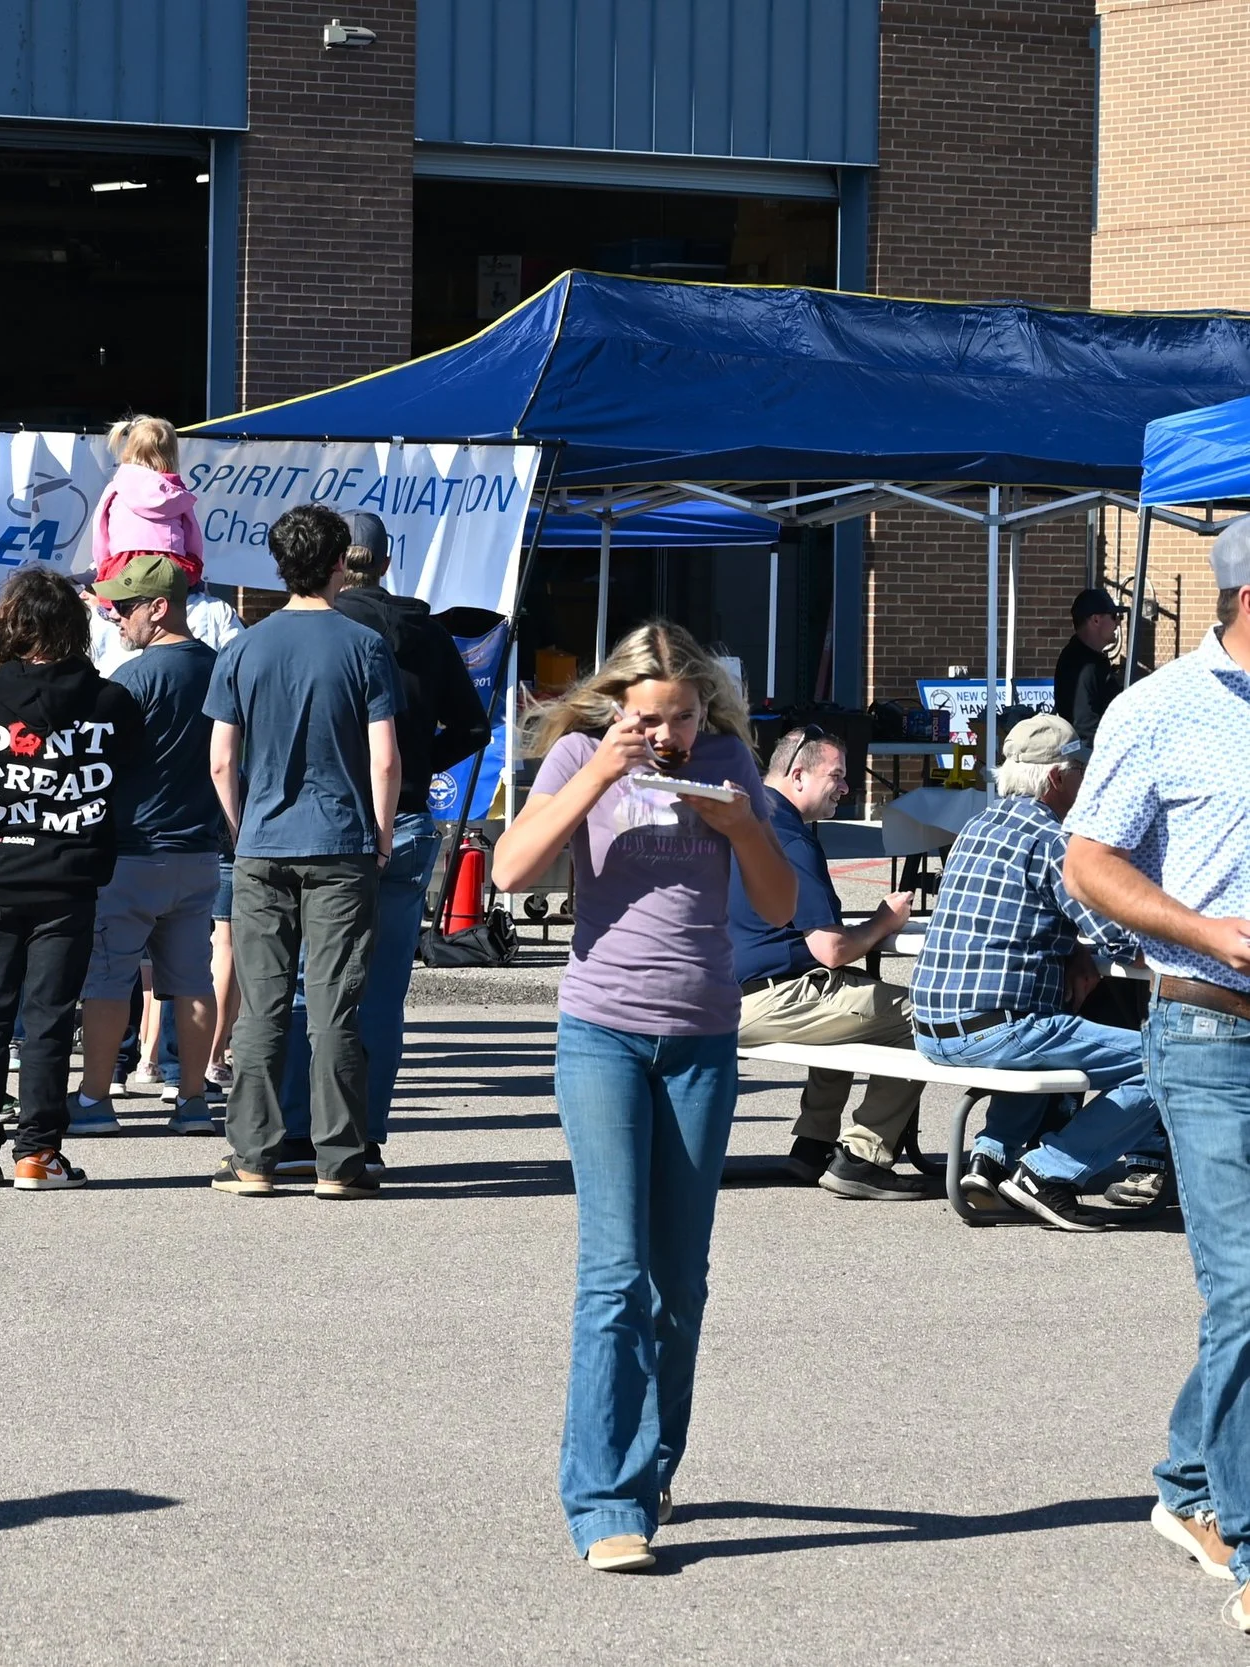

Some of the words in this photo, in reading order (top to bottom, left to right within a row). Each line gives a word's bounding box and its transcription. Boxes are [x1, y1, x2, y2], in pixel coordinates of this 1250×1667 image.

[187, 463, 309, 499] SPIRIT
[310, 467, 365, 502] OF
[358, 474, 518, 517] AVIATION
[956, 691, 978, 702] NEW
[40, 797, 107, 835] ME
